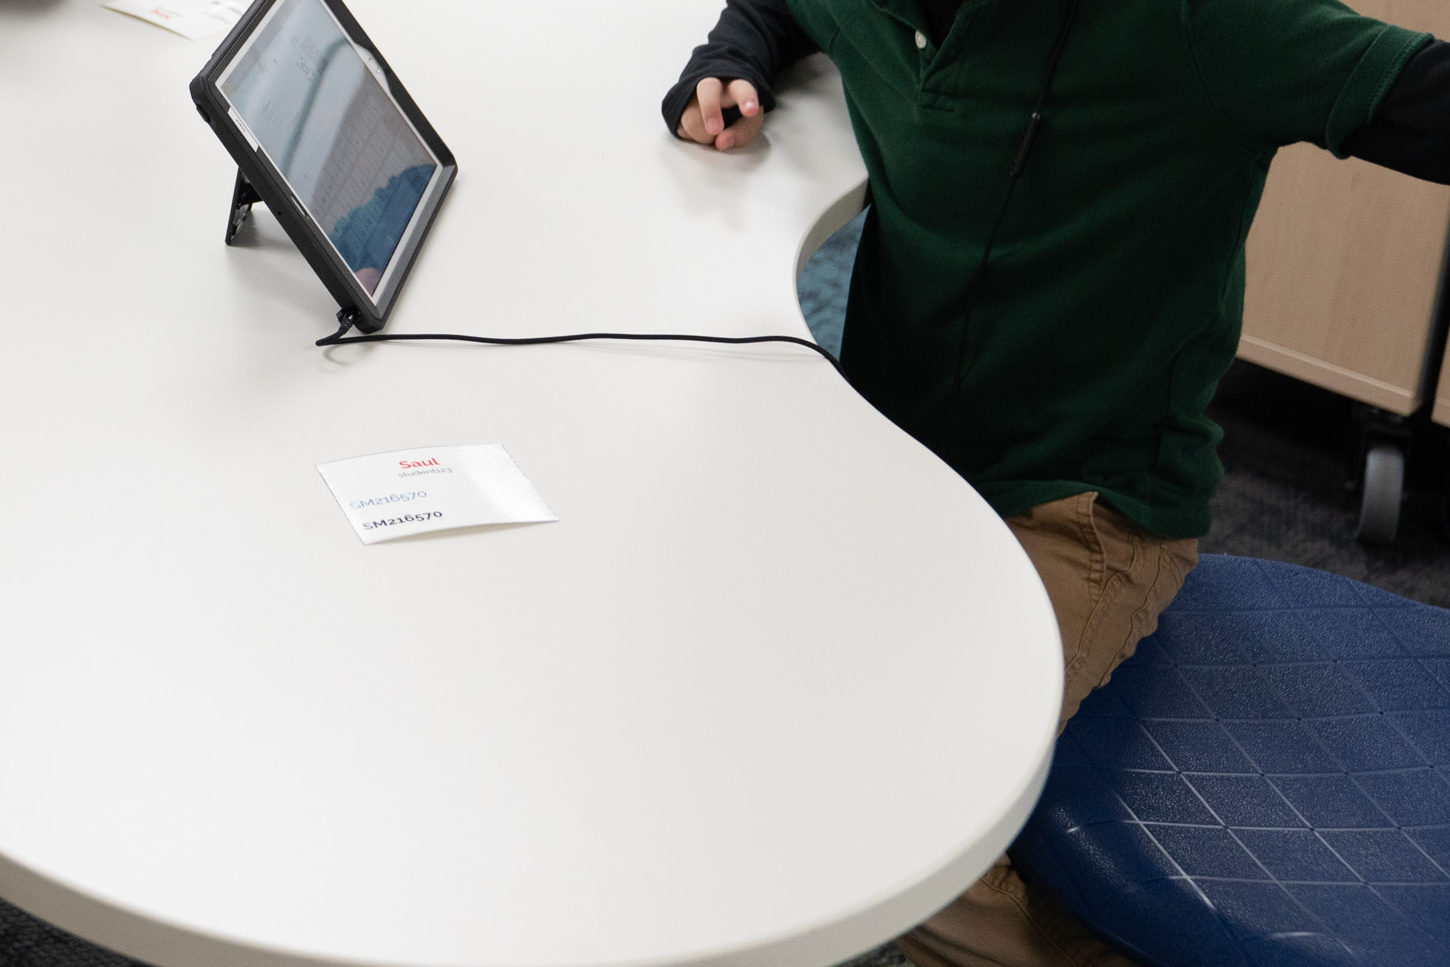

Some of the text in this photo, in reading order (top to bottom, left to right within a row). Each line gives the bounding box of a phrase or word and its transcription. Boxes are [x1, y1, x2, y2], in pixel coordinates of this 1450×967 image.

[398, 457, 441, 469] Saul
[398, 467, 453, 478] student123
[349, 490, 428, 510] SM216570
[362, 510, 443, 530] SM216570
